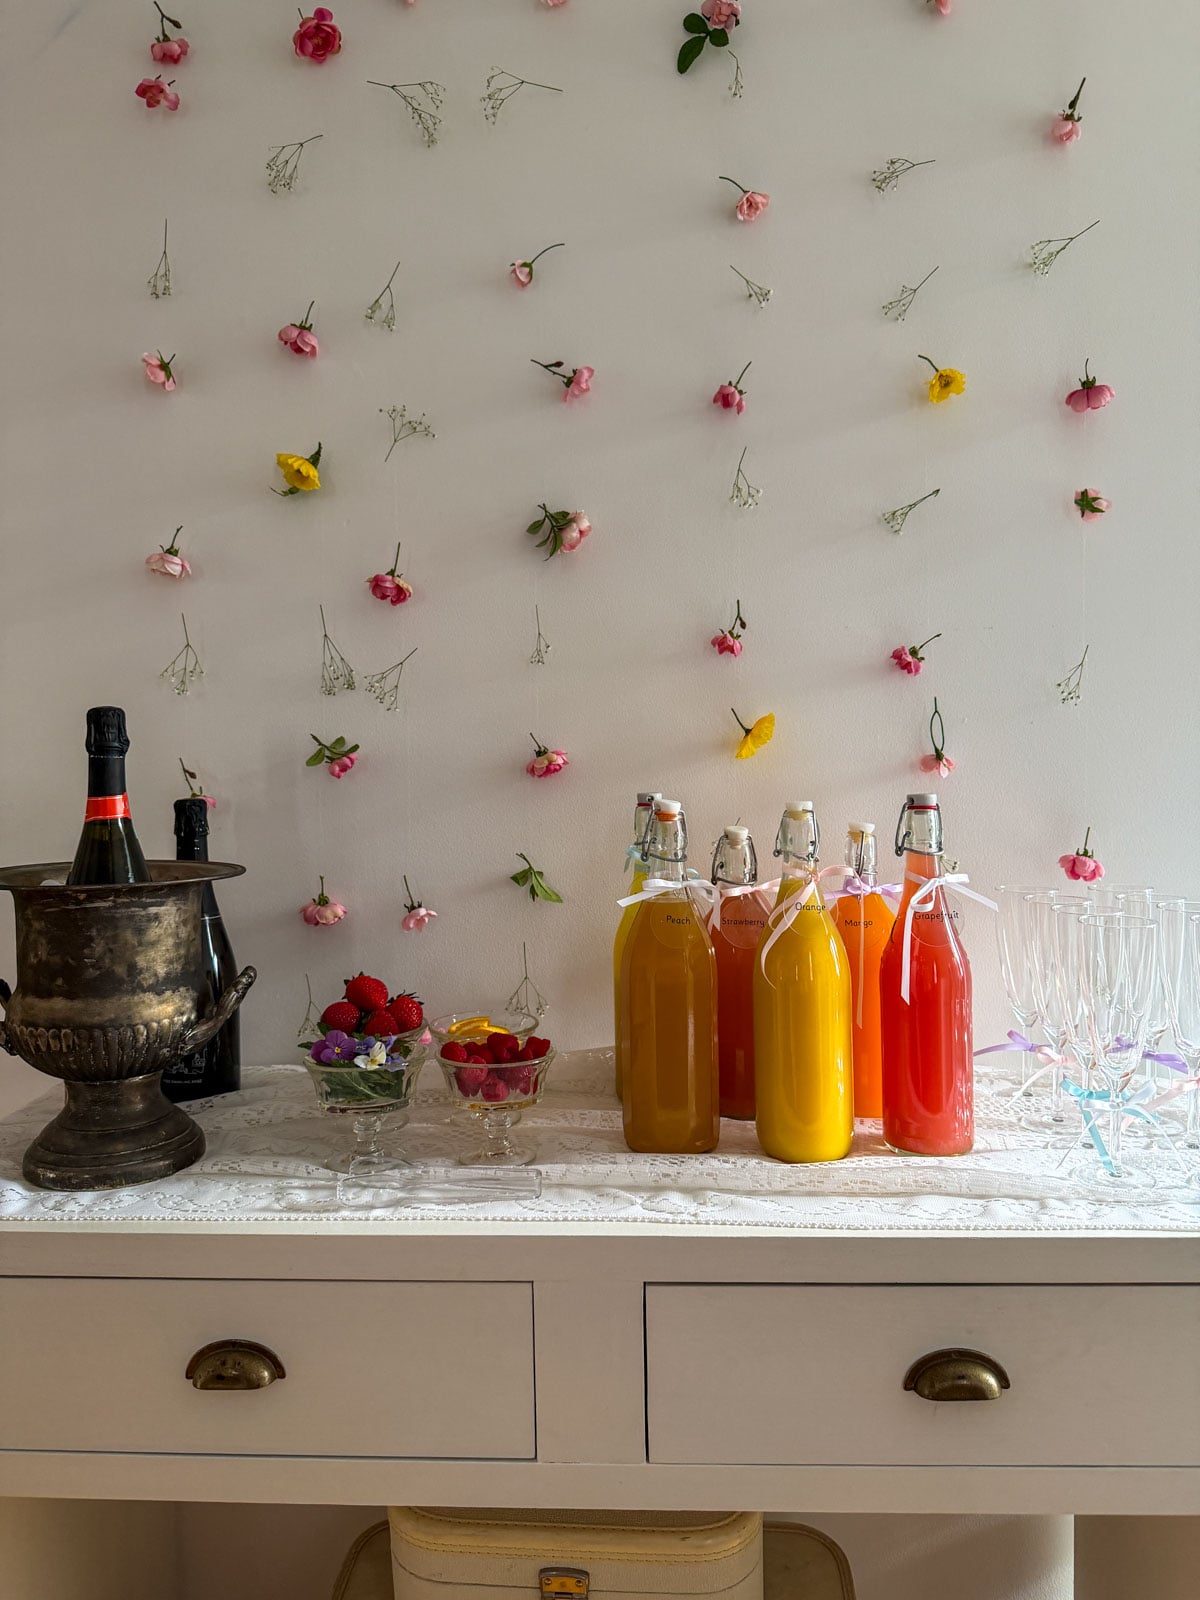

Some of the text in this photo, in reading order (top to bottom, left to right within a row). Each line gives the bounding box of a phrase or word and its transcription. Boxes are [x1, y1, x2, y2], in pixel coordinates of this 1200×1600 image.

[795, 902, 826, 914] Orange
[666, 915, 691, 925] Peach
[721, 917, 765, 928] Strawberry
